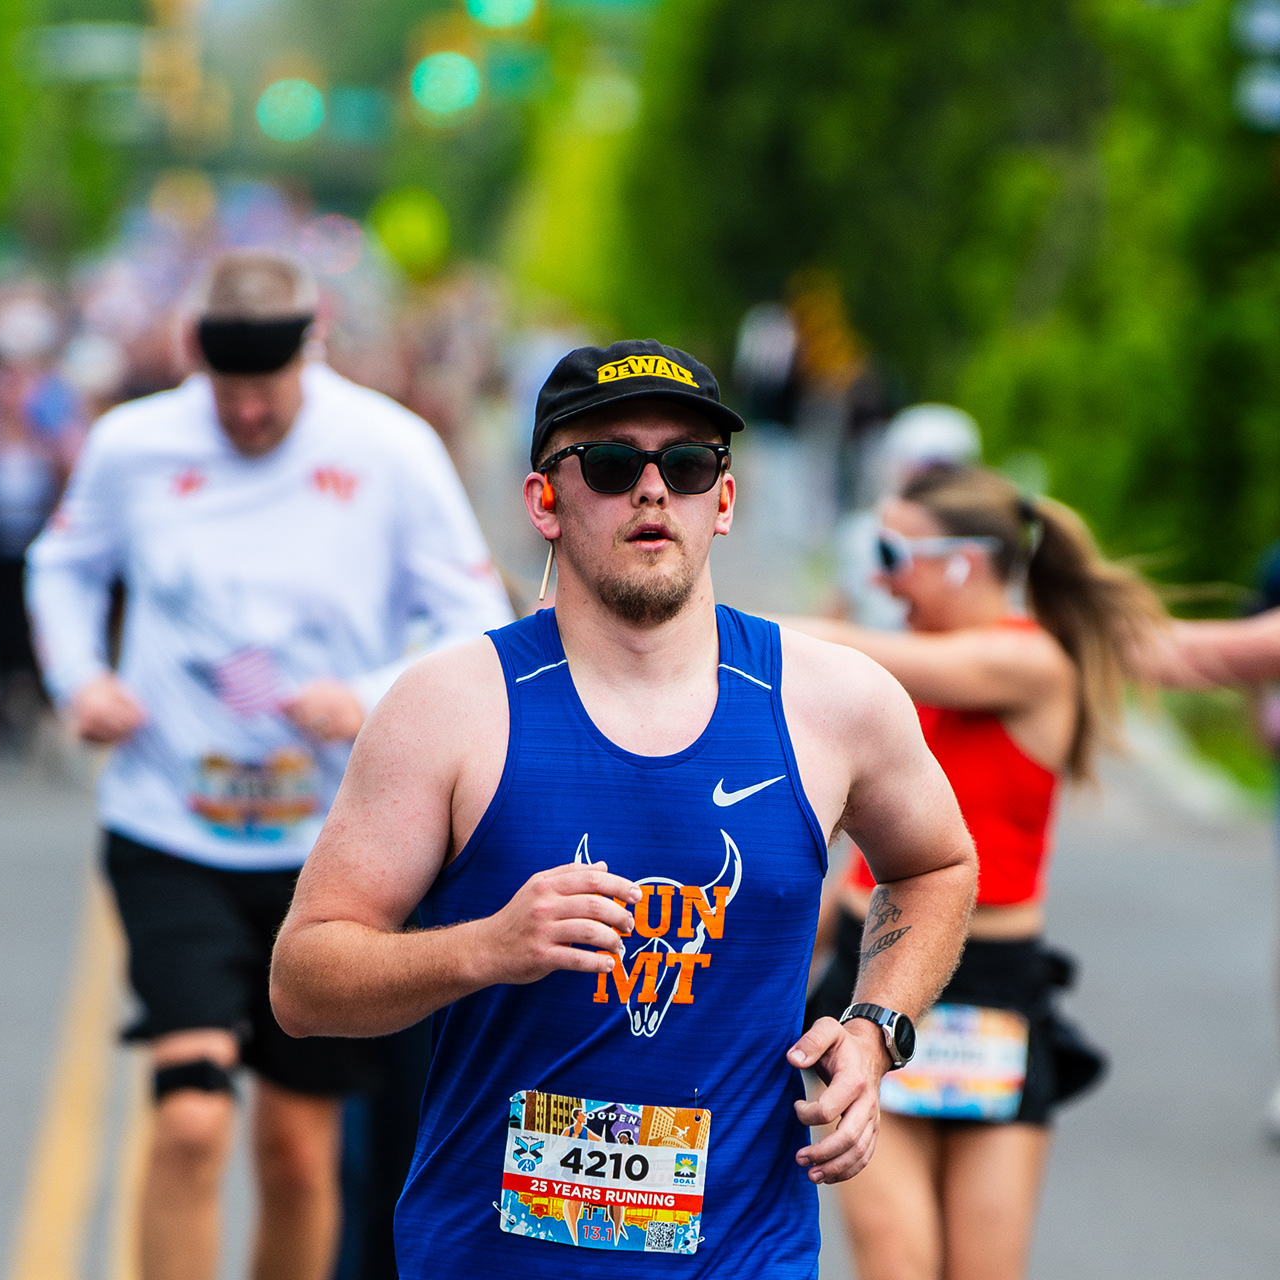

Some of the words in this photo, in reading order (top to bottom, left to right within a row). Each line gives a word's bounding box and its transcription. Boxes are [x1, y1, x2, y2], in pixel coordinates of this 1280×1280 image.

[610, 884, 730, 940] UN
[592, 950, 712, 1004] MT
[586, 1111, 638, 1125] OGDEN
[559, 1147, 650, 1182] 4210
[530, 1179, 548, 1192] 25
[552, 1182, 601, 1201] YEARS
[605, 1189, 675, 1207] RUNNING
[582, 1225, 612, 1241] 13.1
